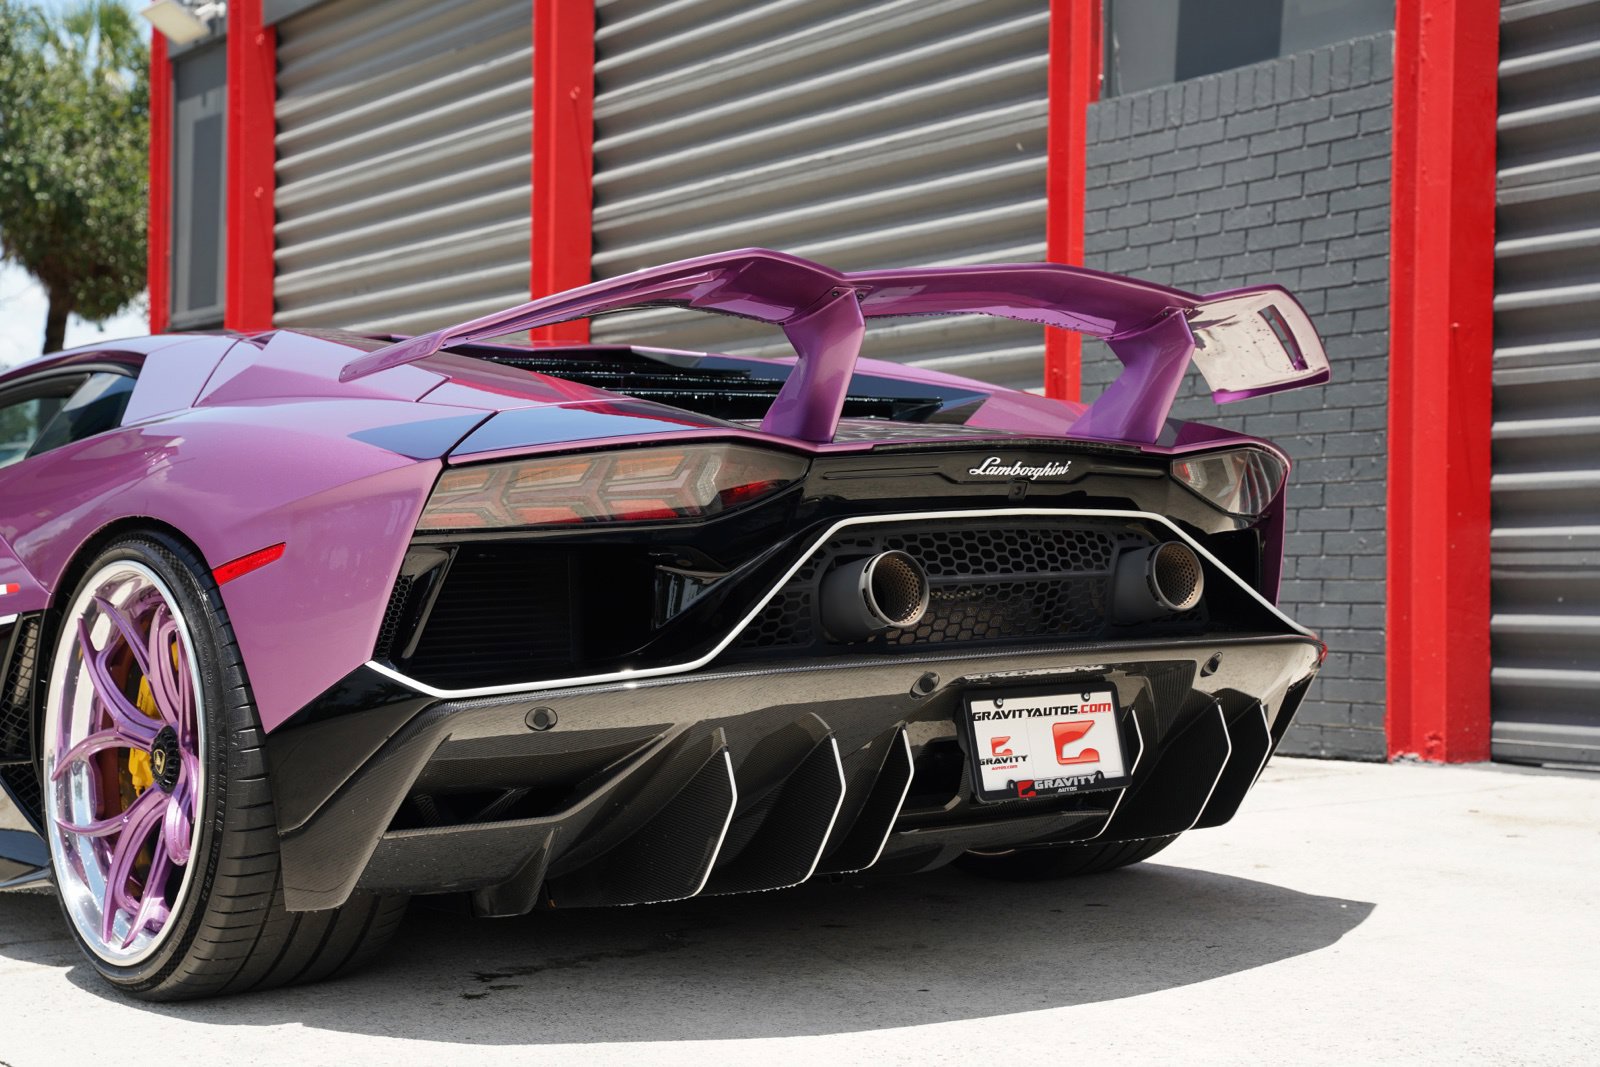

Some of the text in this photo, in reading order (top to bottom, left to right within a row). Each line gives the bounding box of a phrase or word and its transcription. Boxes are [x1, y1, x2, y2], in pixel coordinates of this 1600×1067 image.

[969, 456, 1072, 480] Lamborghini
[980, 755, 1027, 765] GRAVITY
[1034, 774, 1097, 789] GRAVITY
